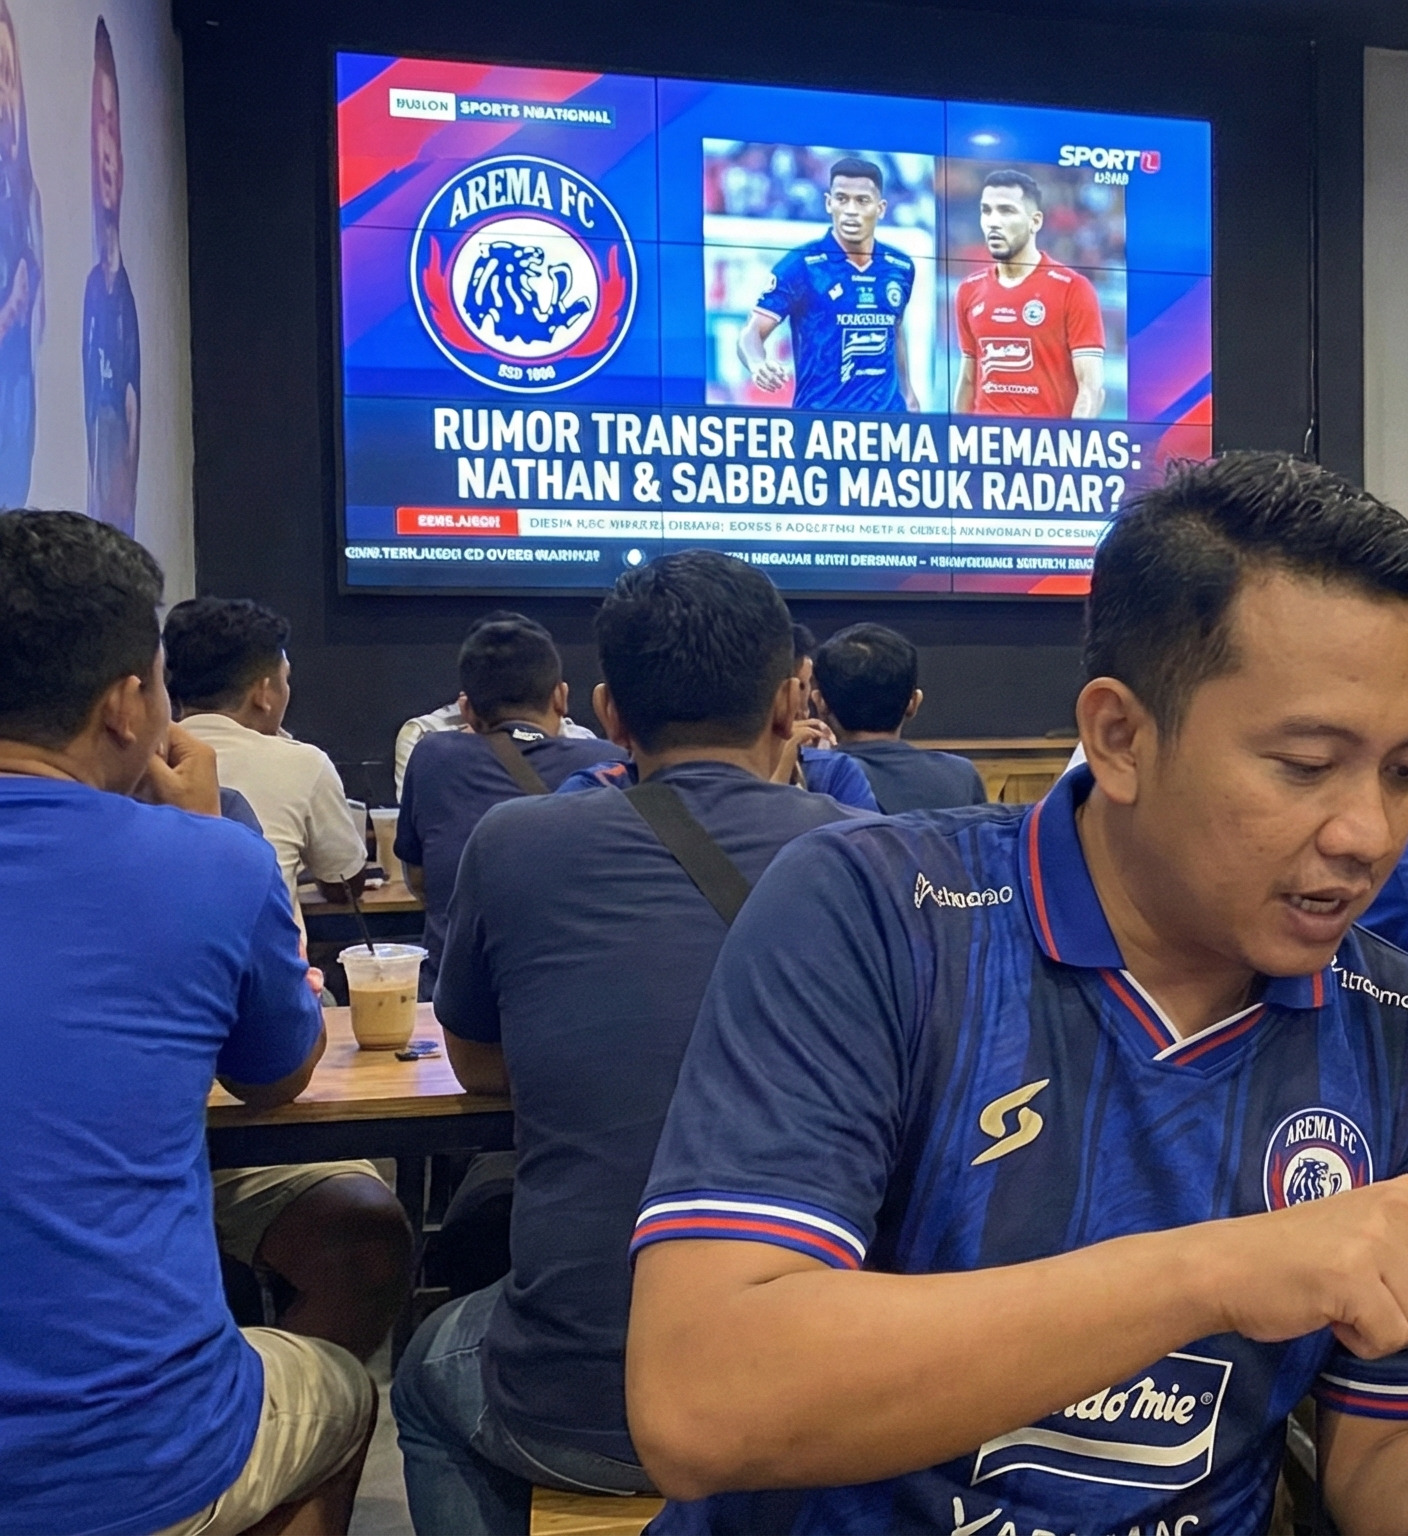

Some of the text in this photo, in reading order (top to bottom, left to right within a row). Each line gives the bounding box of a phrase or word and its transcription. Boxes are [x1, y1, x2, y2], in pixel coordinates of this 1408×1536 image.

[1058, 144, 1141, 171] SPORT
[449, 167, 595, 229] AREMA FC
[434, 407, 1142, 470] RUMOR TRANSFER AREMA MEMANAS:
[458, 456, 1126, 515] NATHAN & SABBAG MASUK RADAR?
[1285, 1115, 1357, 1154] AREMA FC
